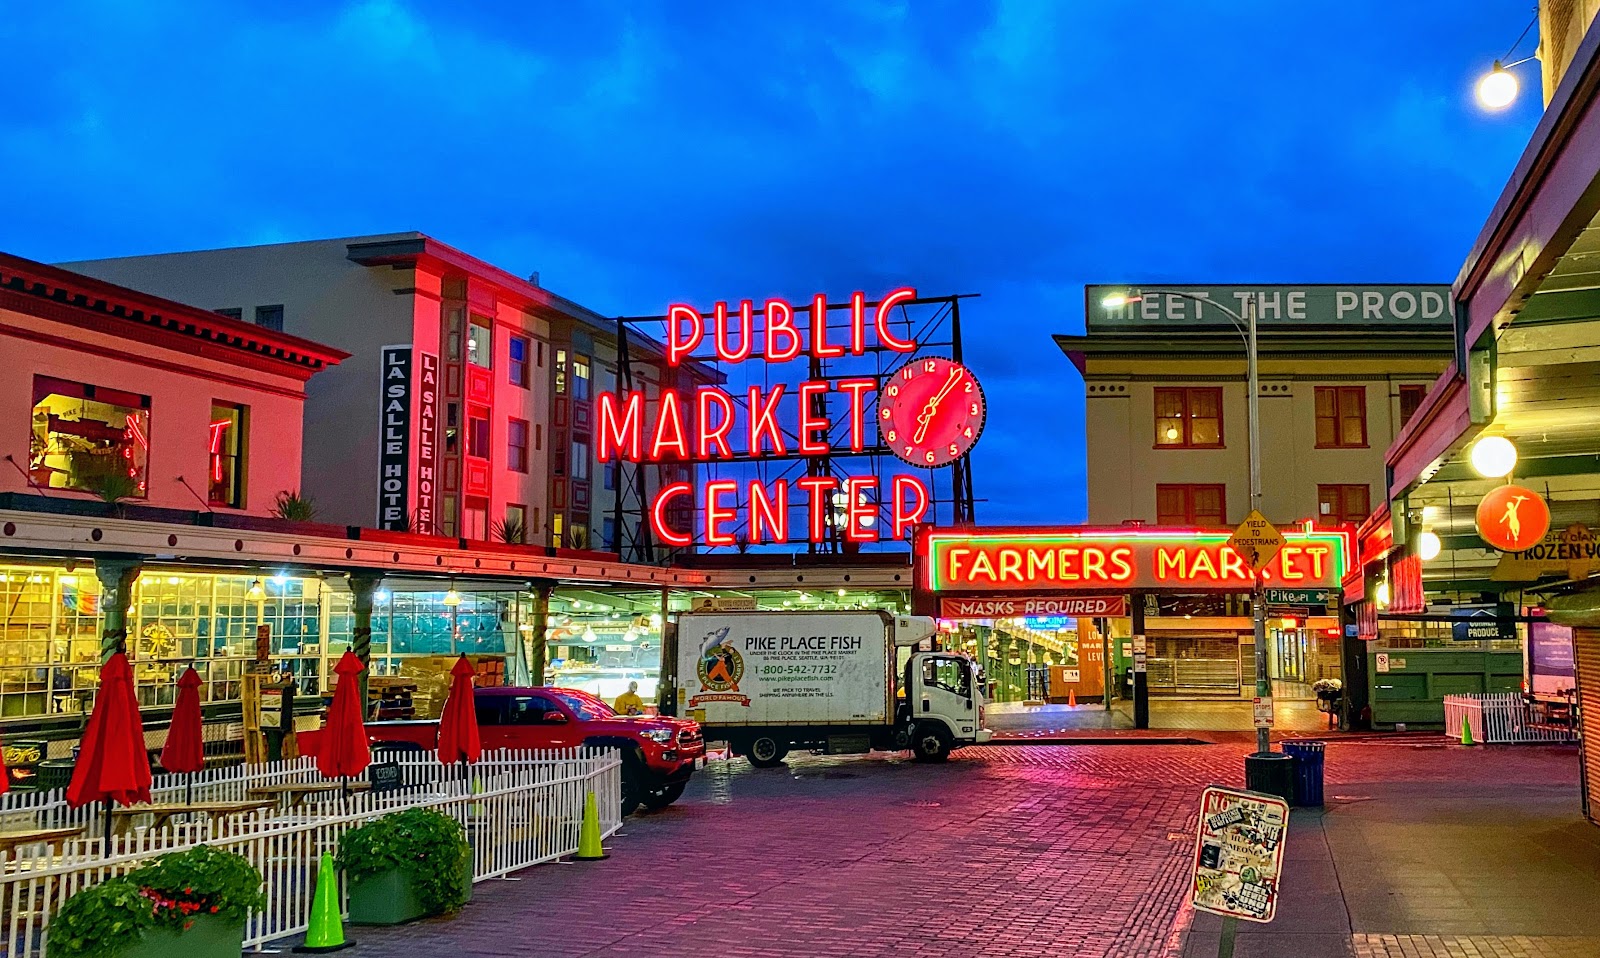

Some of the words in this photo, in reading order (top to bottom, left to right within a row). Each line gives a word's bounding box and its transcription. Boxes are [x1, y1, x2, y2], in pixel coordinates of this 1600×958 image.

[1233, 291, 1306, 319] THE
[1336, 291, 1454, 319] PROD
[668, 287, 917, 367] PUBLIC
[387, 353, 405, 379] LA
[423, 356, 435, 385] LA
[924, 361, 935, 372] 12
[903, 369, 912, 379] 11
[887, 386, 898, 396] 10
[965, 382, 972, 392] 2
[882, 409, 890, 419] 9
[971, 404, 978, 415] 3
[386, 385, 405, 455] SALLE
[421, 391, 434, 459] SALLE
[598, 378, 878, 463] MARKET
[888, 431, 896, 442] 8
[964, 428, 972, 438] 4
[905, 447, 912, 456] 7
[950, 444, 957, 455] 5
[926, 452, 934, 462] 6
[419, 466, 433, 535] HOTEL
[652, 475, 929, 546] CENTER
[1570, 531, 1600, 541] GIAN
[949, 548, 1132, 582] FARMERS
[1157, 547, 1329, 580] MARET
[1270, 590, 1294, 602] Pike
[1300, 594, 1309, 602] Pl
[960, 602, 1015, 615] MASKS
[1025, 600, 1107, 614] REQUIRED
[1468, 628, 1499, 637] PRODUCE
[745, 637, 777, 650] PIKE
[780, 636, 827, 650] PLACE
[830, 636, 862, 649] FISH
[754, 665, 837, 674] 1-800-542-7732
